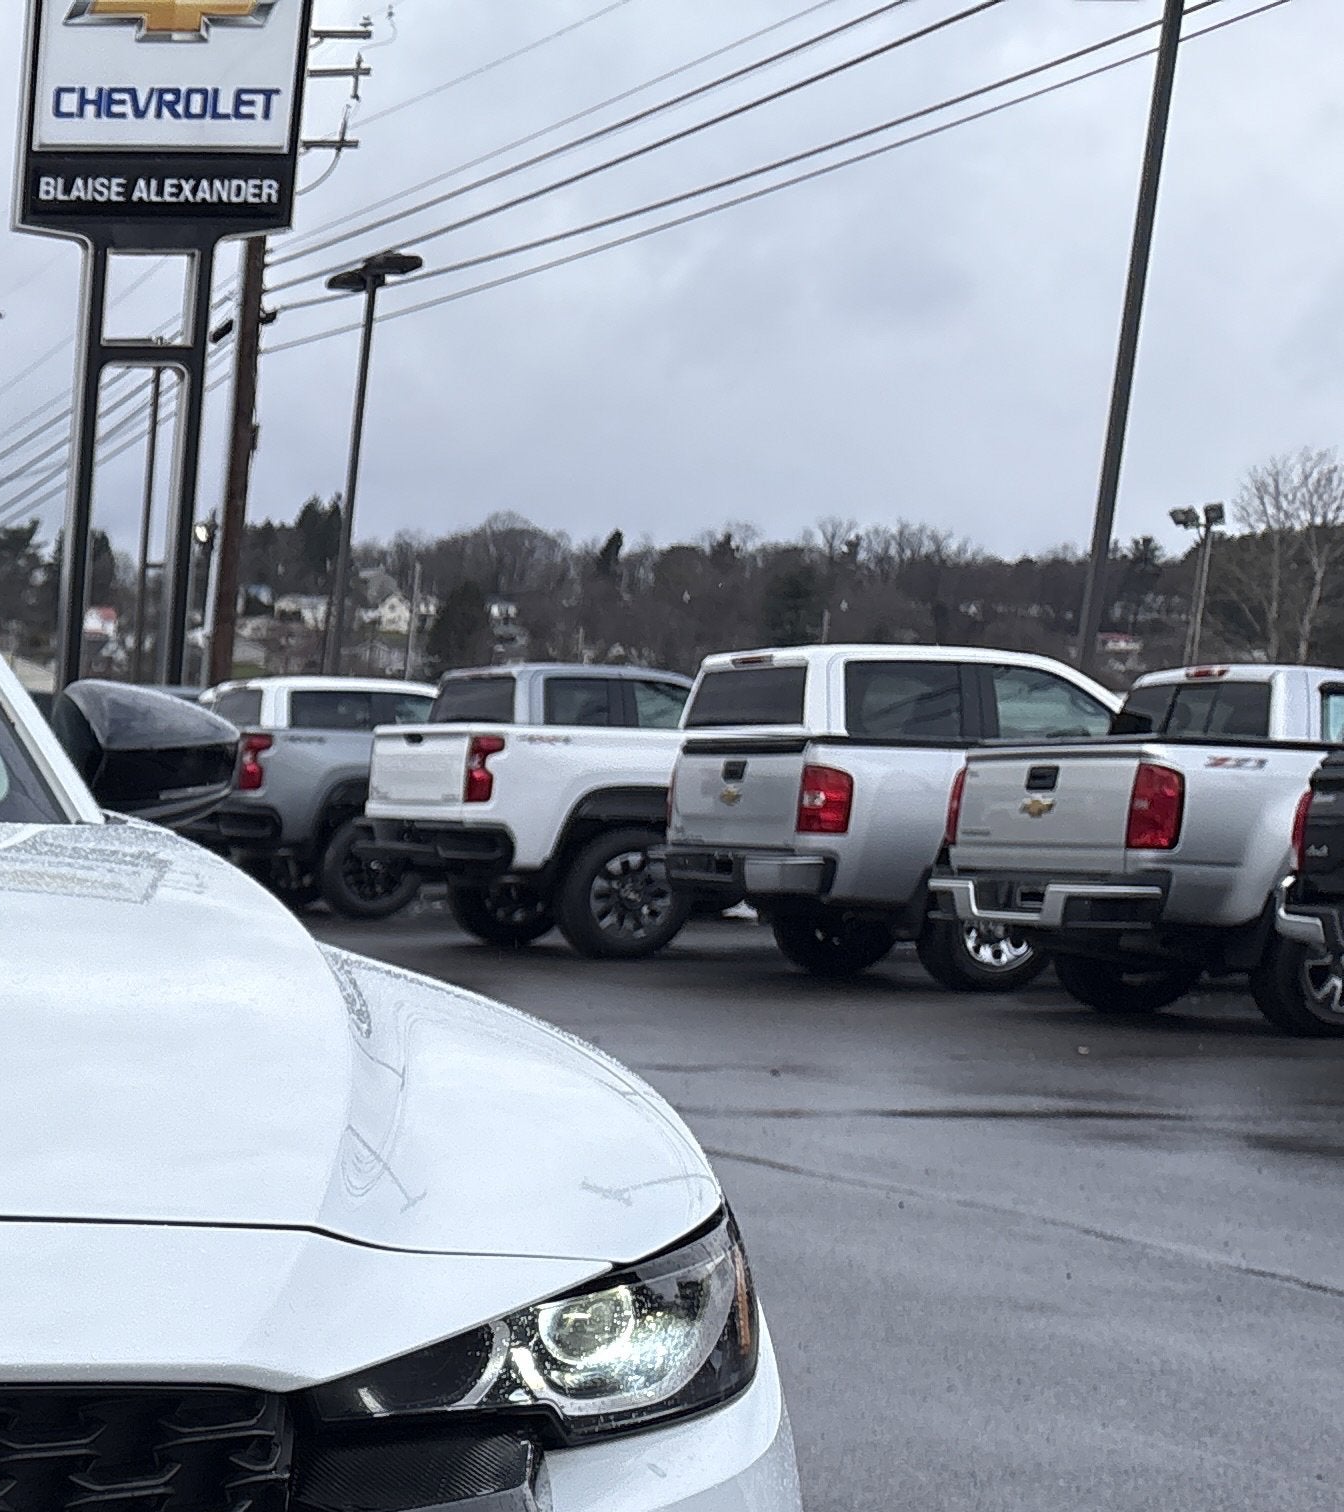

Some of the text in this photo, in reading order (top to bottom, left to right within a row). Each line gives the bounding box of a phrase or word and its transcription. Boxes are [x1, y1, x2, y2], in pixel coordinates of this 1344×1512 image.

[52, 87, 281, 120] CHEVROLET
[39, 177, 280, 203] BLAISE ALEXANDER
